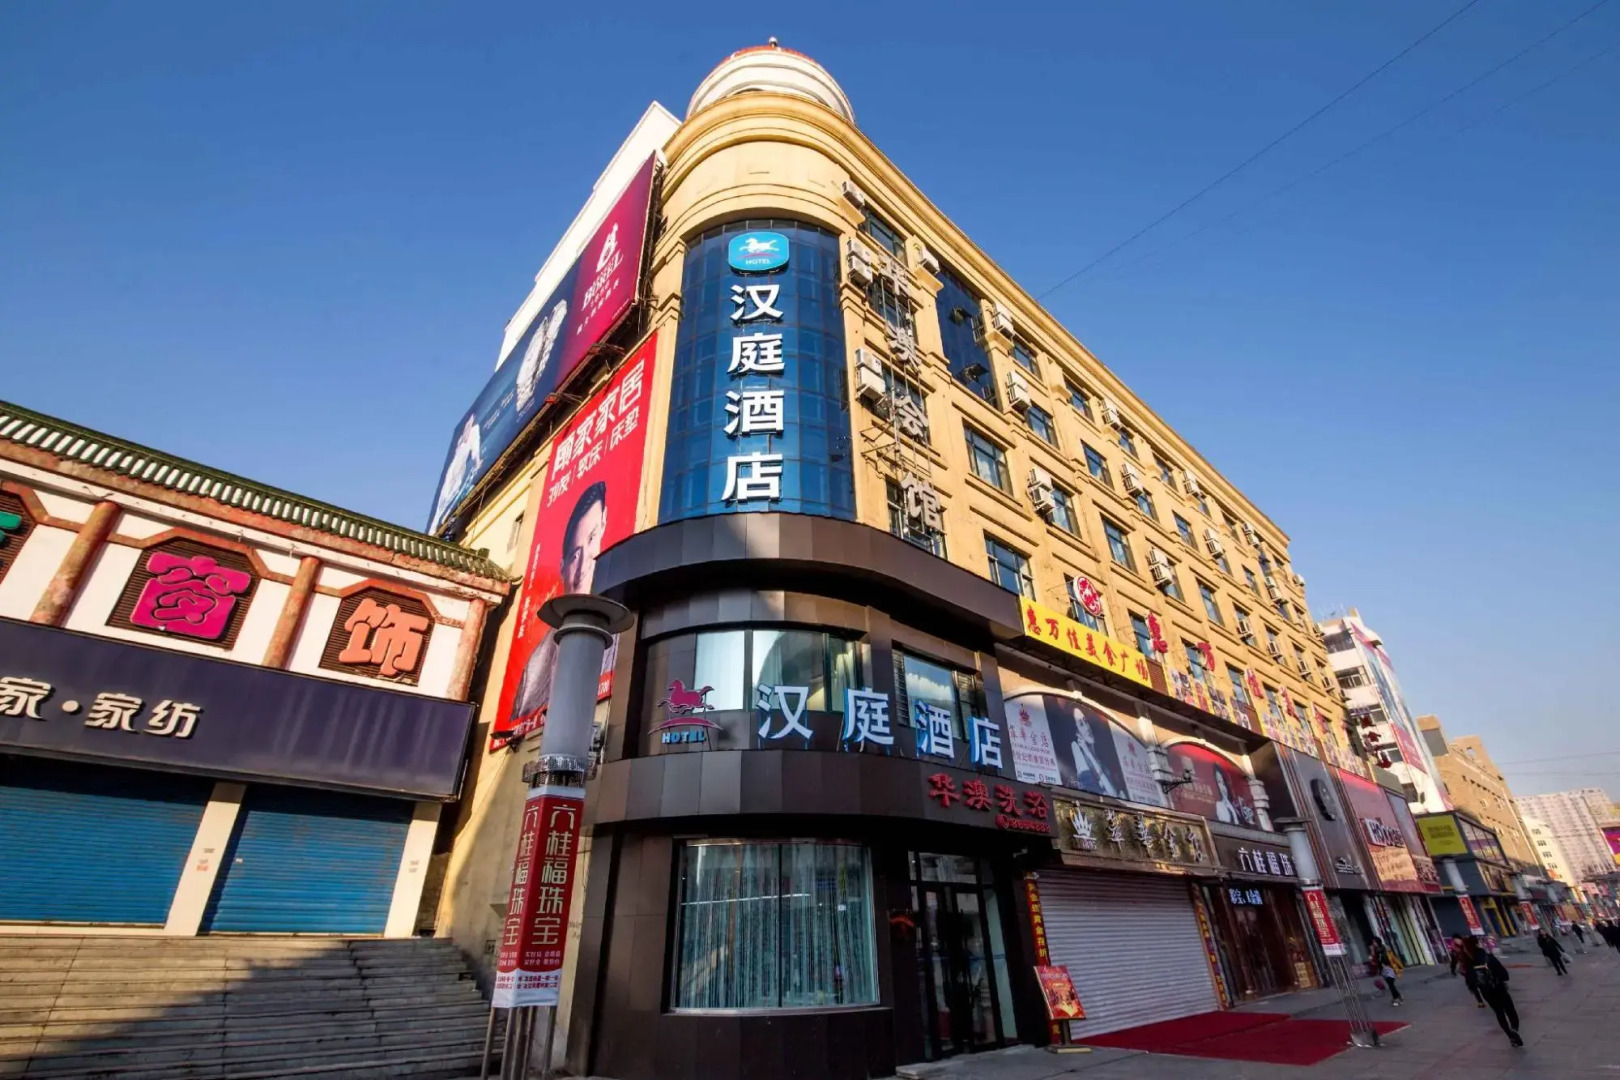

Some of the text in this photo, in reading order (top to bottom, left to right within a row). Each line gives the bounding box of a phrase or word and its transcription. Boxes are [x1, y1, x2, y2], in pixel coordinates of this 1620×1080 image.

[745, 257, 772, 266] HOTEL
[550, 358, 645, 482] 顾家家居
[721, 282, 785, 502] 汉庭酒店
[661, 731, 707, 745] HOTEL
[757, 683, 1003, 769] 汉庭酒店
[928, 772, 1050, 819] 华澳洗浴
[503, 804, 539, 946] 六桂福珠宝
[531, 803, 577, 946] 六桂福珠宝
[1238, 846, 1296, 877] 六桂福珠
